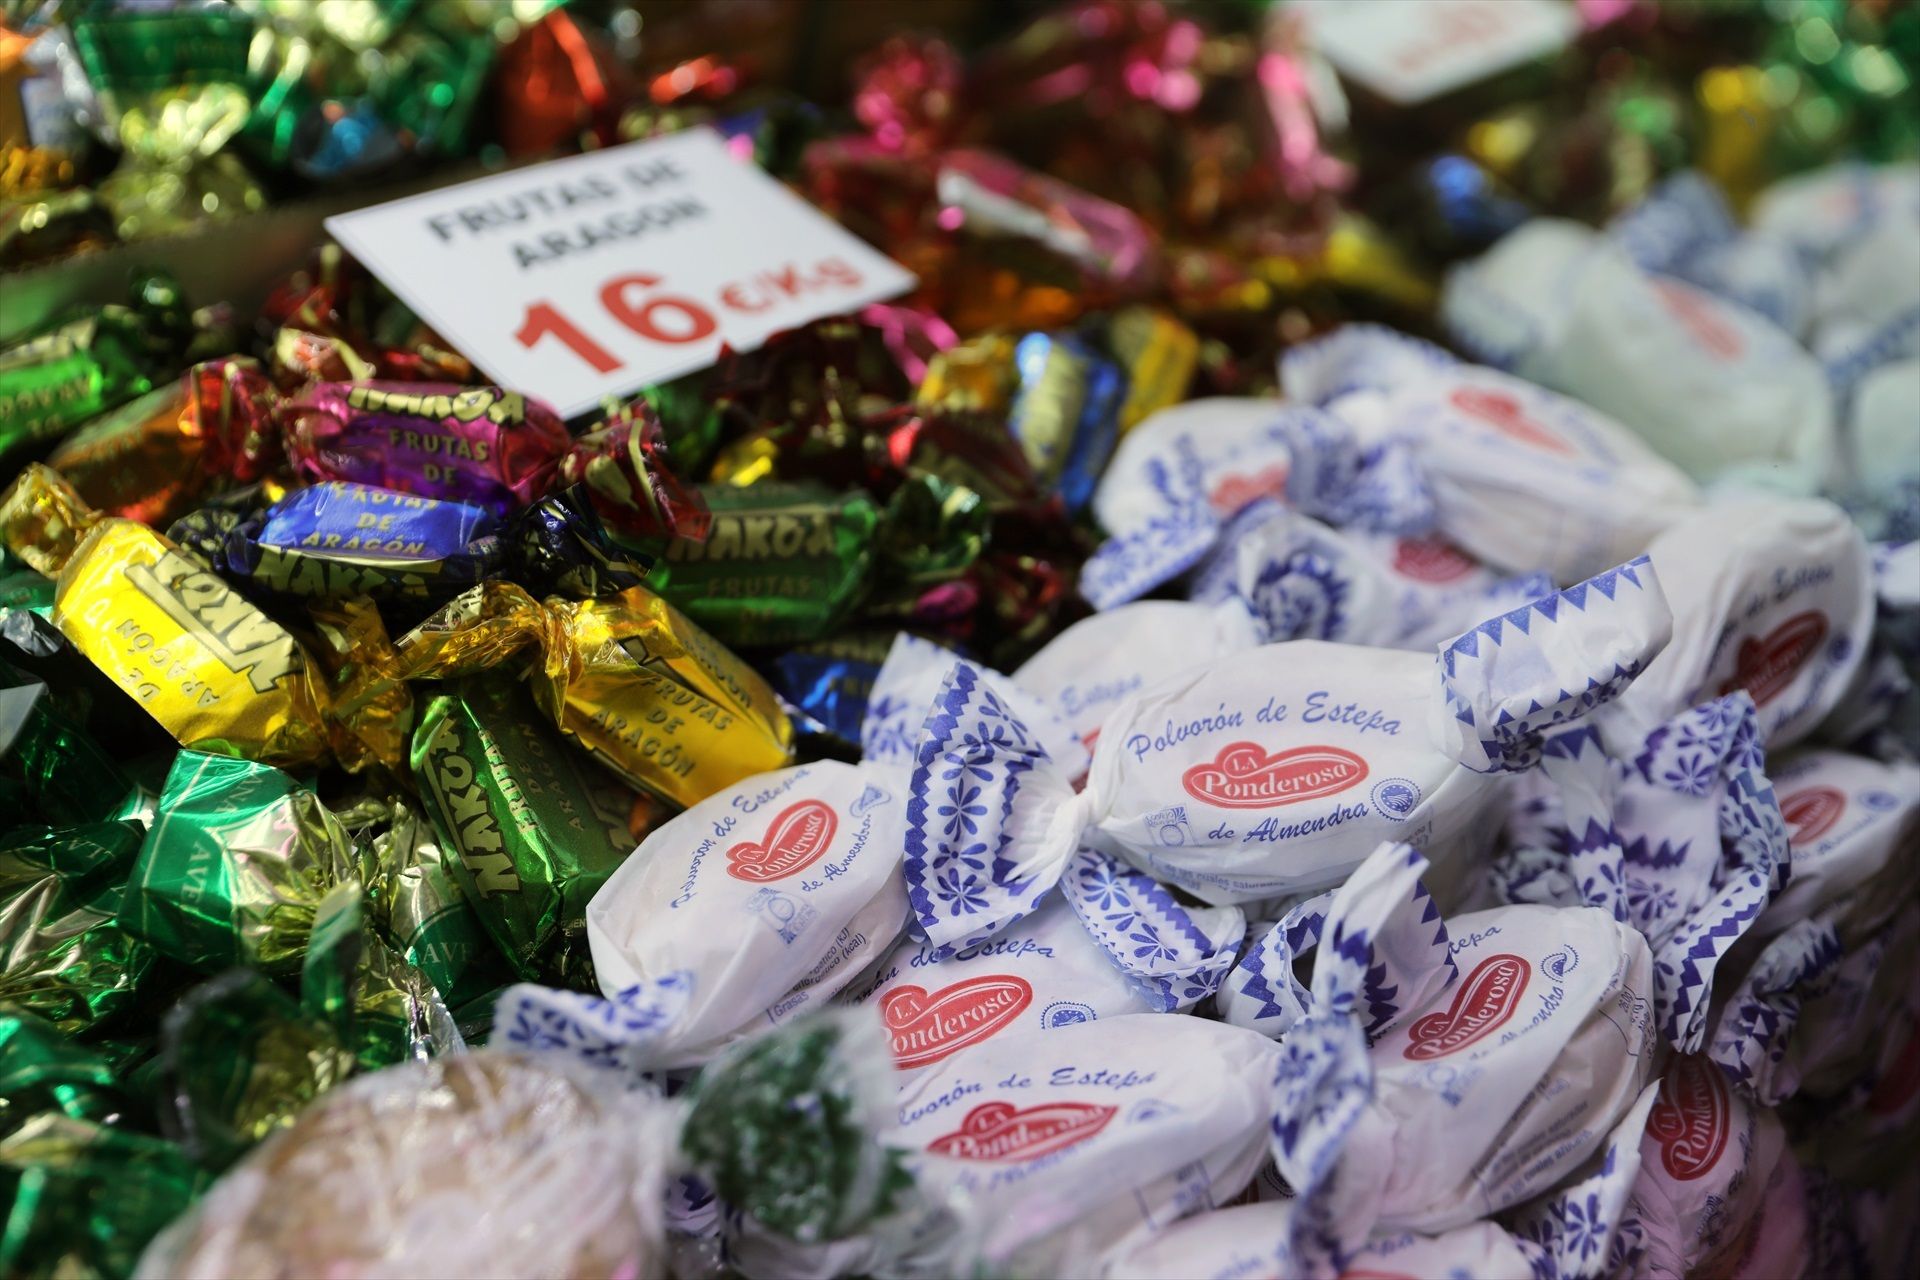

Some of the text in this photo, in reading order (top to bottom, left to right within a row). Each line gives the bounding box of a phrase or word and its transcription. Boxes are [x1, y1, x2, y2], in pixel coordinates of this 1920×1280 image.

[424, 156, 687, 244] FRUTAS DE
[514, 271, 718, 375] 16
[388, 427, 491, 462] FRUTAS
[422, 463, 458, 487] DE
[356, 512, 396, 531] DE
[301, 531, 425, 555] ARAGÓN
[121, 667, 162, 703] DE
[640, 675, 734, 732] FRUTAS
[646, 708, 686, 736] DE
[1127, 691, 1402, 762] Polvorón de Estepa
[591, 709, 697, 779] ARAGÓN
[1203, 761, 1348, 797] Ponderosa
[1231, 753, 1259, 772] LA
[715, 816, 737, 837] de
[1208, 822, 1235, 840] de
[1243, 802, 1370, 843] Almendra
[744, 814, 823, 876] Ponderosa
[802, 879, 823, 893] de
[773, 991, 810, 1017] Grasas
[894, 1000, 921, 1020] LA
[1421, 966, 1516, 1053] Ponderosa
[900, 1066, 1157, 1126] lvorón de Estepa
